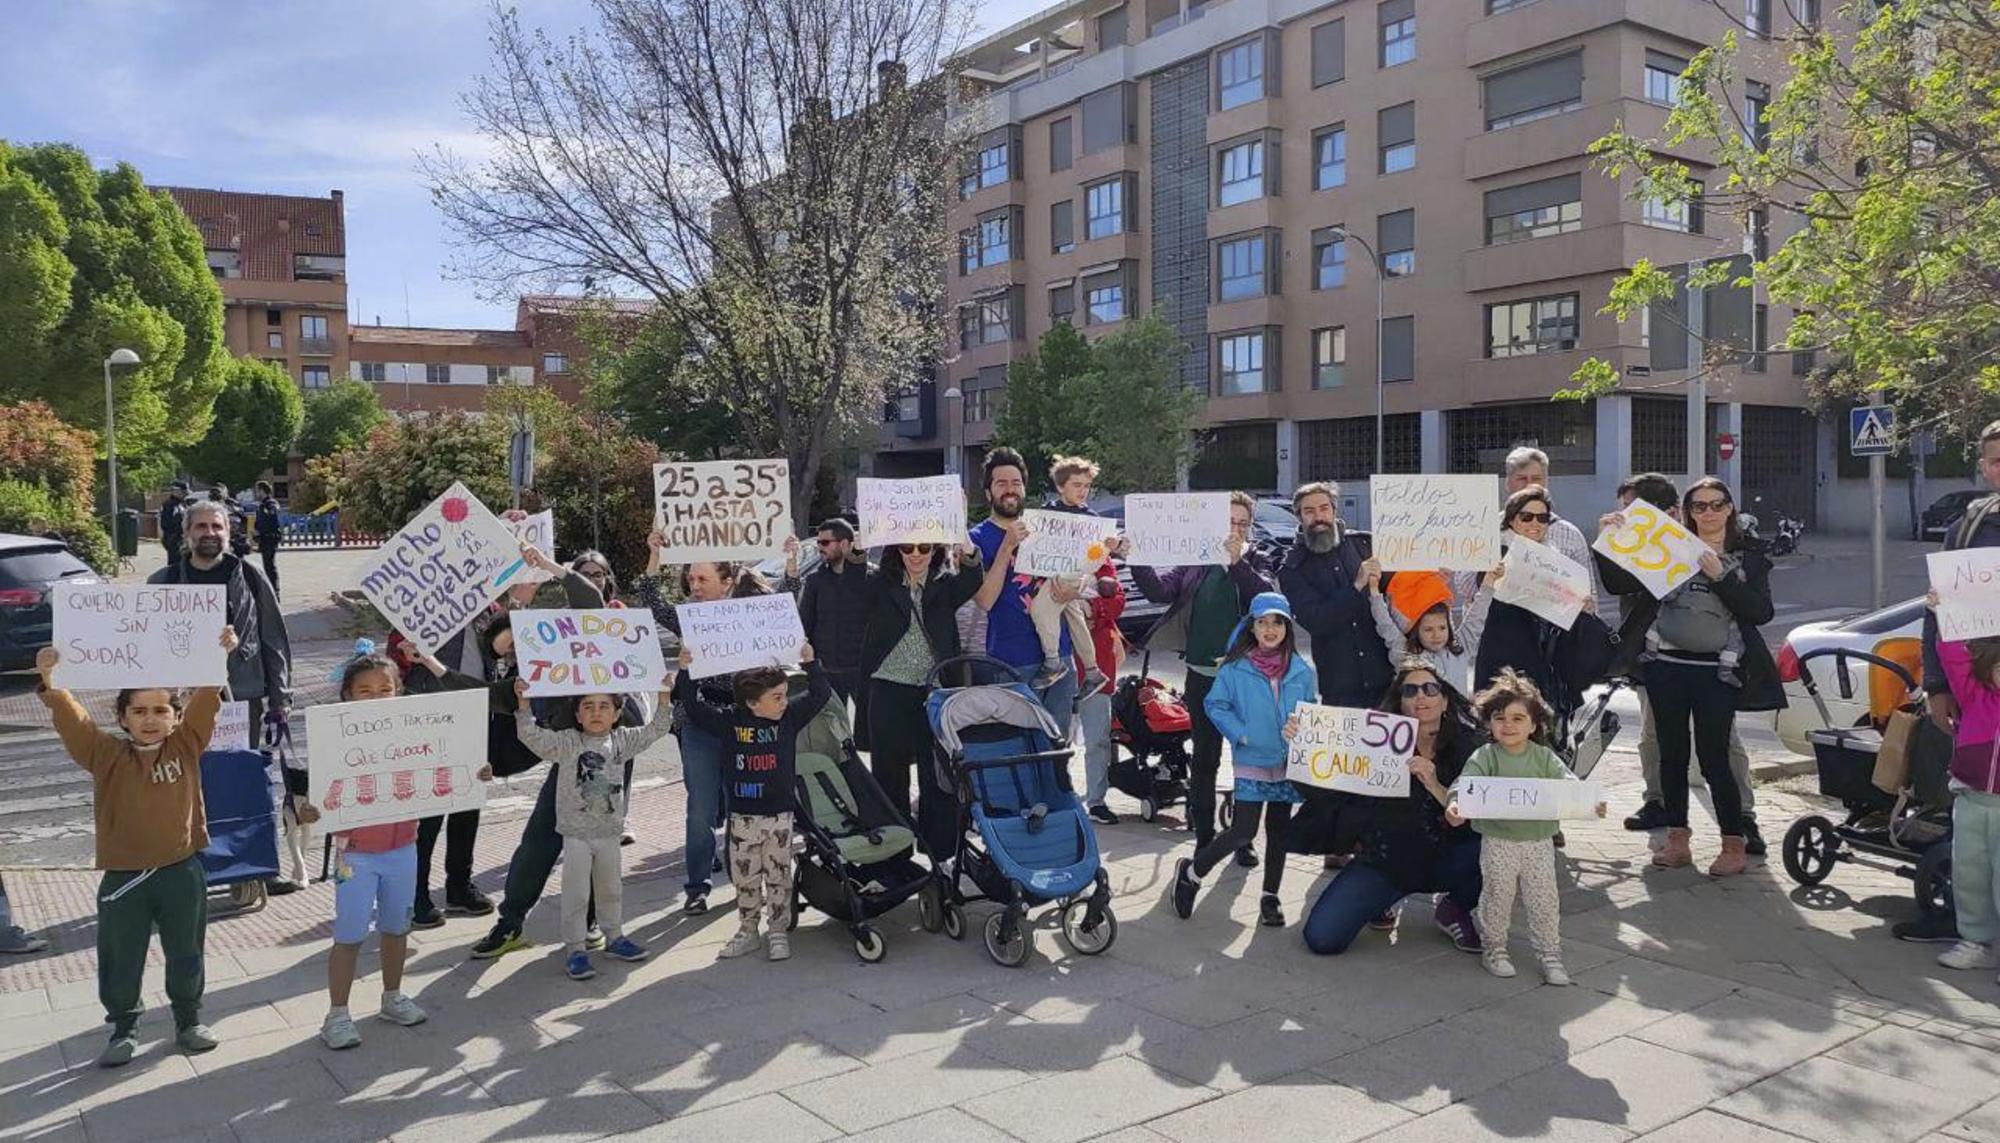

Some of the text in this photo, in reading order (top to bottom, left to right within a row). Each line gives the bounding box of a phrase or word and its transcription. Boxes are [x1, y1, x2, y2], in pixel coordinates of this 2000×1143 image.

[659, 467, 699, 498] 25
[707, 476, 729, 499] a
[361, 522, 442, 596] mucho
[384, 545, 448, 614] calor
[68, 588, 220, 614] QUIERO ESTUDIAR
[402, 558, 482, 632] escuela
[420, 575, 489, 647] sudor
[519, 614, 650, 654] FONDOS
[700, 633, 797, 660] POLLO ASADO
[67, 638, 143, 669] SUDAR
[570, 641, 602, 659] PA
[528, 654, 648, 686] TOLDOS
[734, 725, 779, 743] THE SKY
[1291, 731, 1356, 748] GOLPES
[1361, 711, 1414, 755] 50
[152, 757, 182, 784] HEY
[747, 754, 777, 771] YOUR
[1291, 749, 1309, 771] DE
[1311, 749, 1372, 779] CALOR
[735, 782, 765, 799] LIMIT
[1367, 770, 1401, 789] 2022
[1508, 787, 1539, 807] EN
